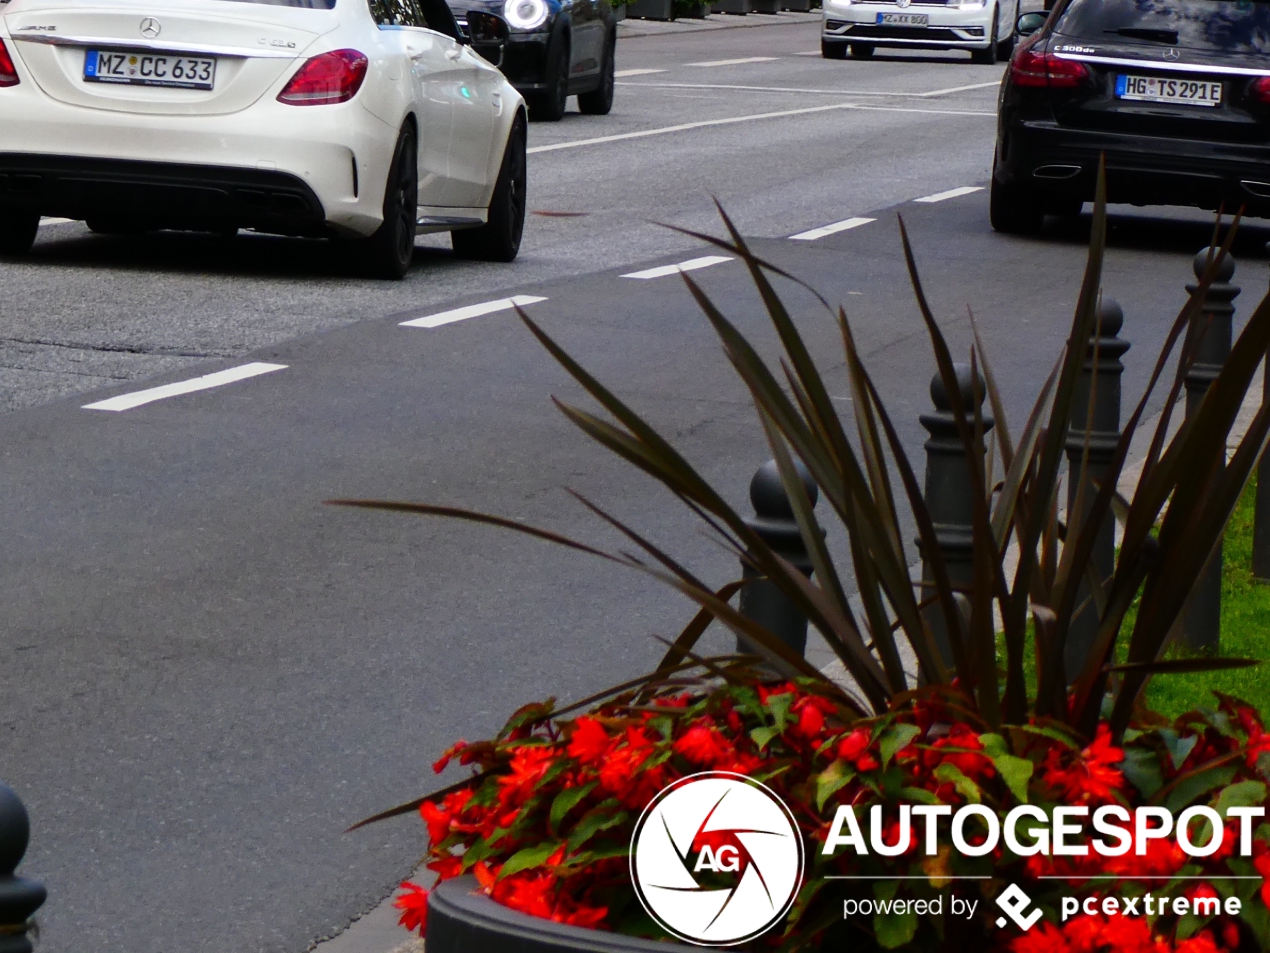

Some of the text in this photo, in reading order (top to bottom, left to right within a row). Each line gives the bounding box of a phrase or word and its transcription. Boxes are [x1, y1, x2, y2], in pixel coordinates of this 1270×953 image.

[98, 54, 126, 75] MZ
[140, 57, 167, 77] CC
[172, 59, 213, 81] 633
[1126, 77, 1147, 94] HG
[1158, 80, 1177, 97] TS
